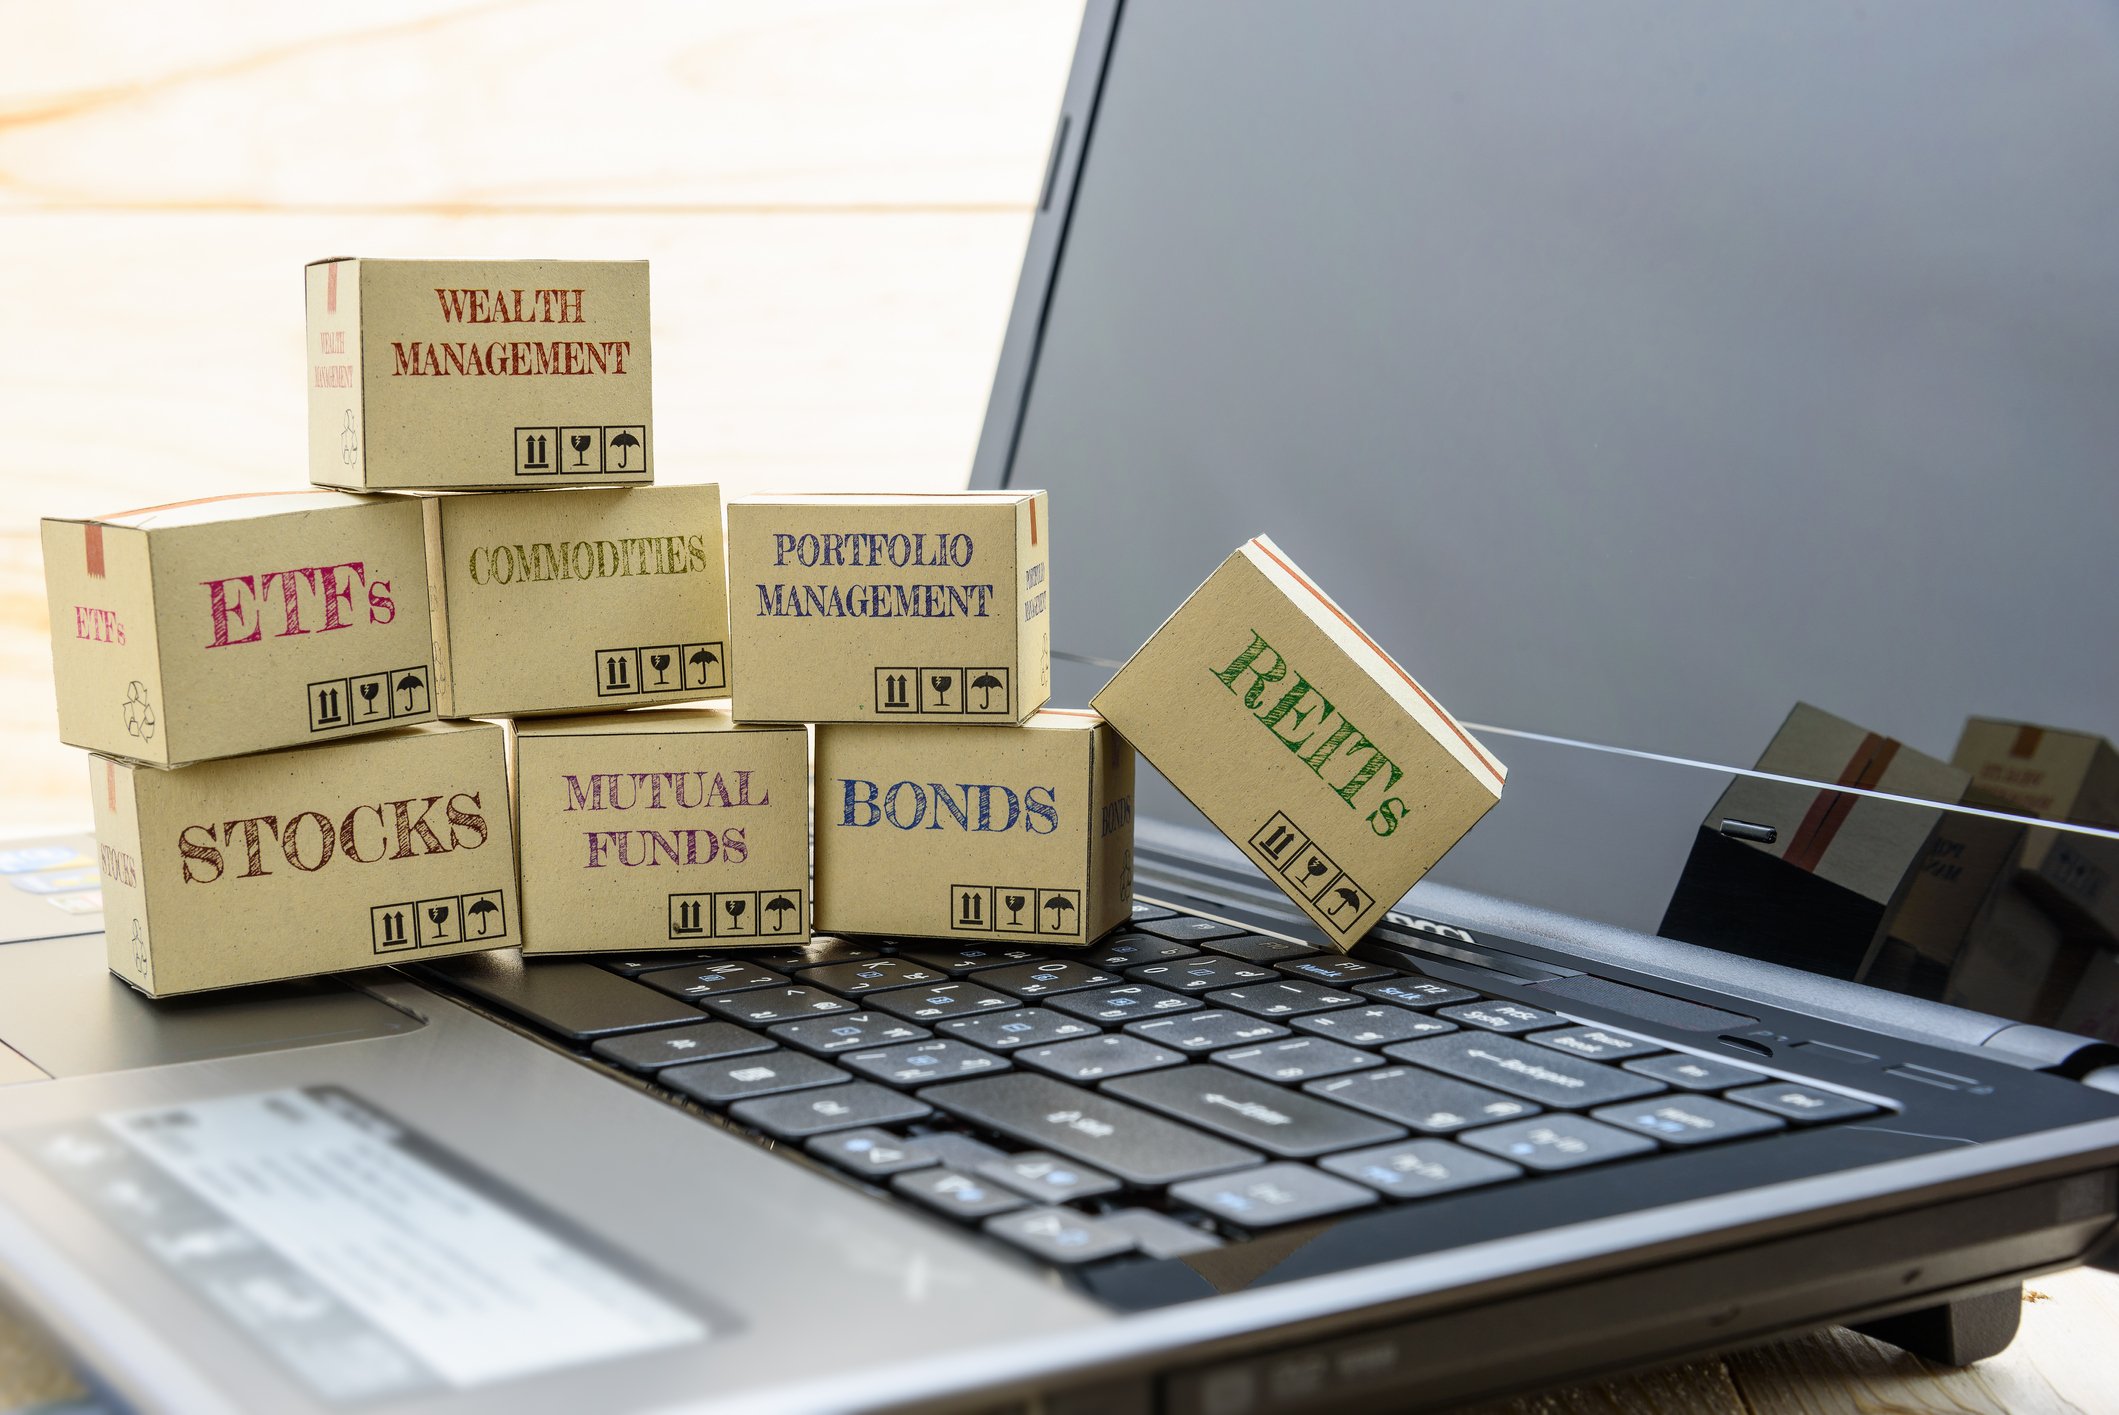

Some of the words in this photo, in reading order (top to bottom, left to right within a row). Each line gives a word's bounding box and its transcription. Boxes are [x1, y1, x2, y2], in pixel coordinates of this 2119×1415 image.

[434, 288, 586, 324] WEALTH
[320, 331, 345, 354] WEALTH
[391, 341, 630, 377] MANAGEMENT
[469, 534, 706, 585] COMMODITIES
[773, 533, 974, 568] PORTFOLIO
[200, 561, 396, 649] ETFs
[756, 584, 993, 619] MANAGEMENT
[74, 605, 127, 646] ETFs
[1209, 629, 1410, 837] REITs
[562, 771, 769, 812] MUTUAL
[837, 778, 1058, 834] BONDS
[1101, 794, 1131, 838] BONDS
[178, 792, 488, 884] STOCKS
[583, 828, 748, 868] FUNDS
[100, 844, 137, 888] STOCKS
[862, 961, 896, 969] K
[1335, 962, 1366, 971] F11
[1414, 984, 1448, 995] F12
